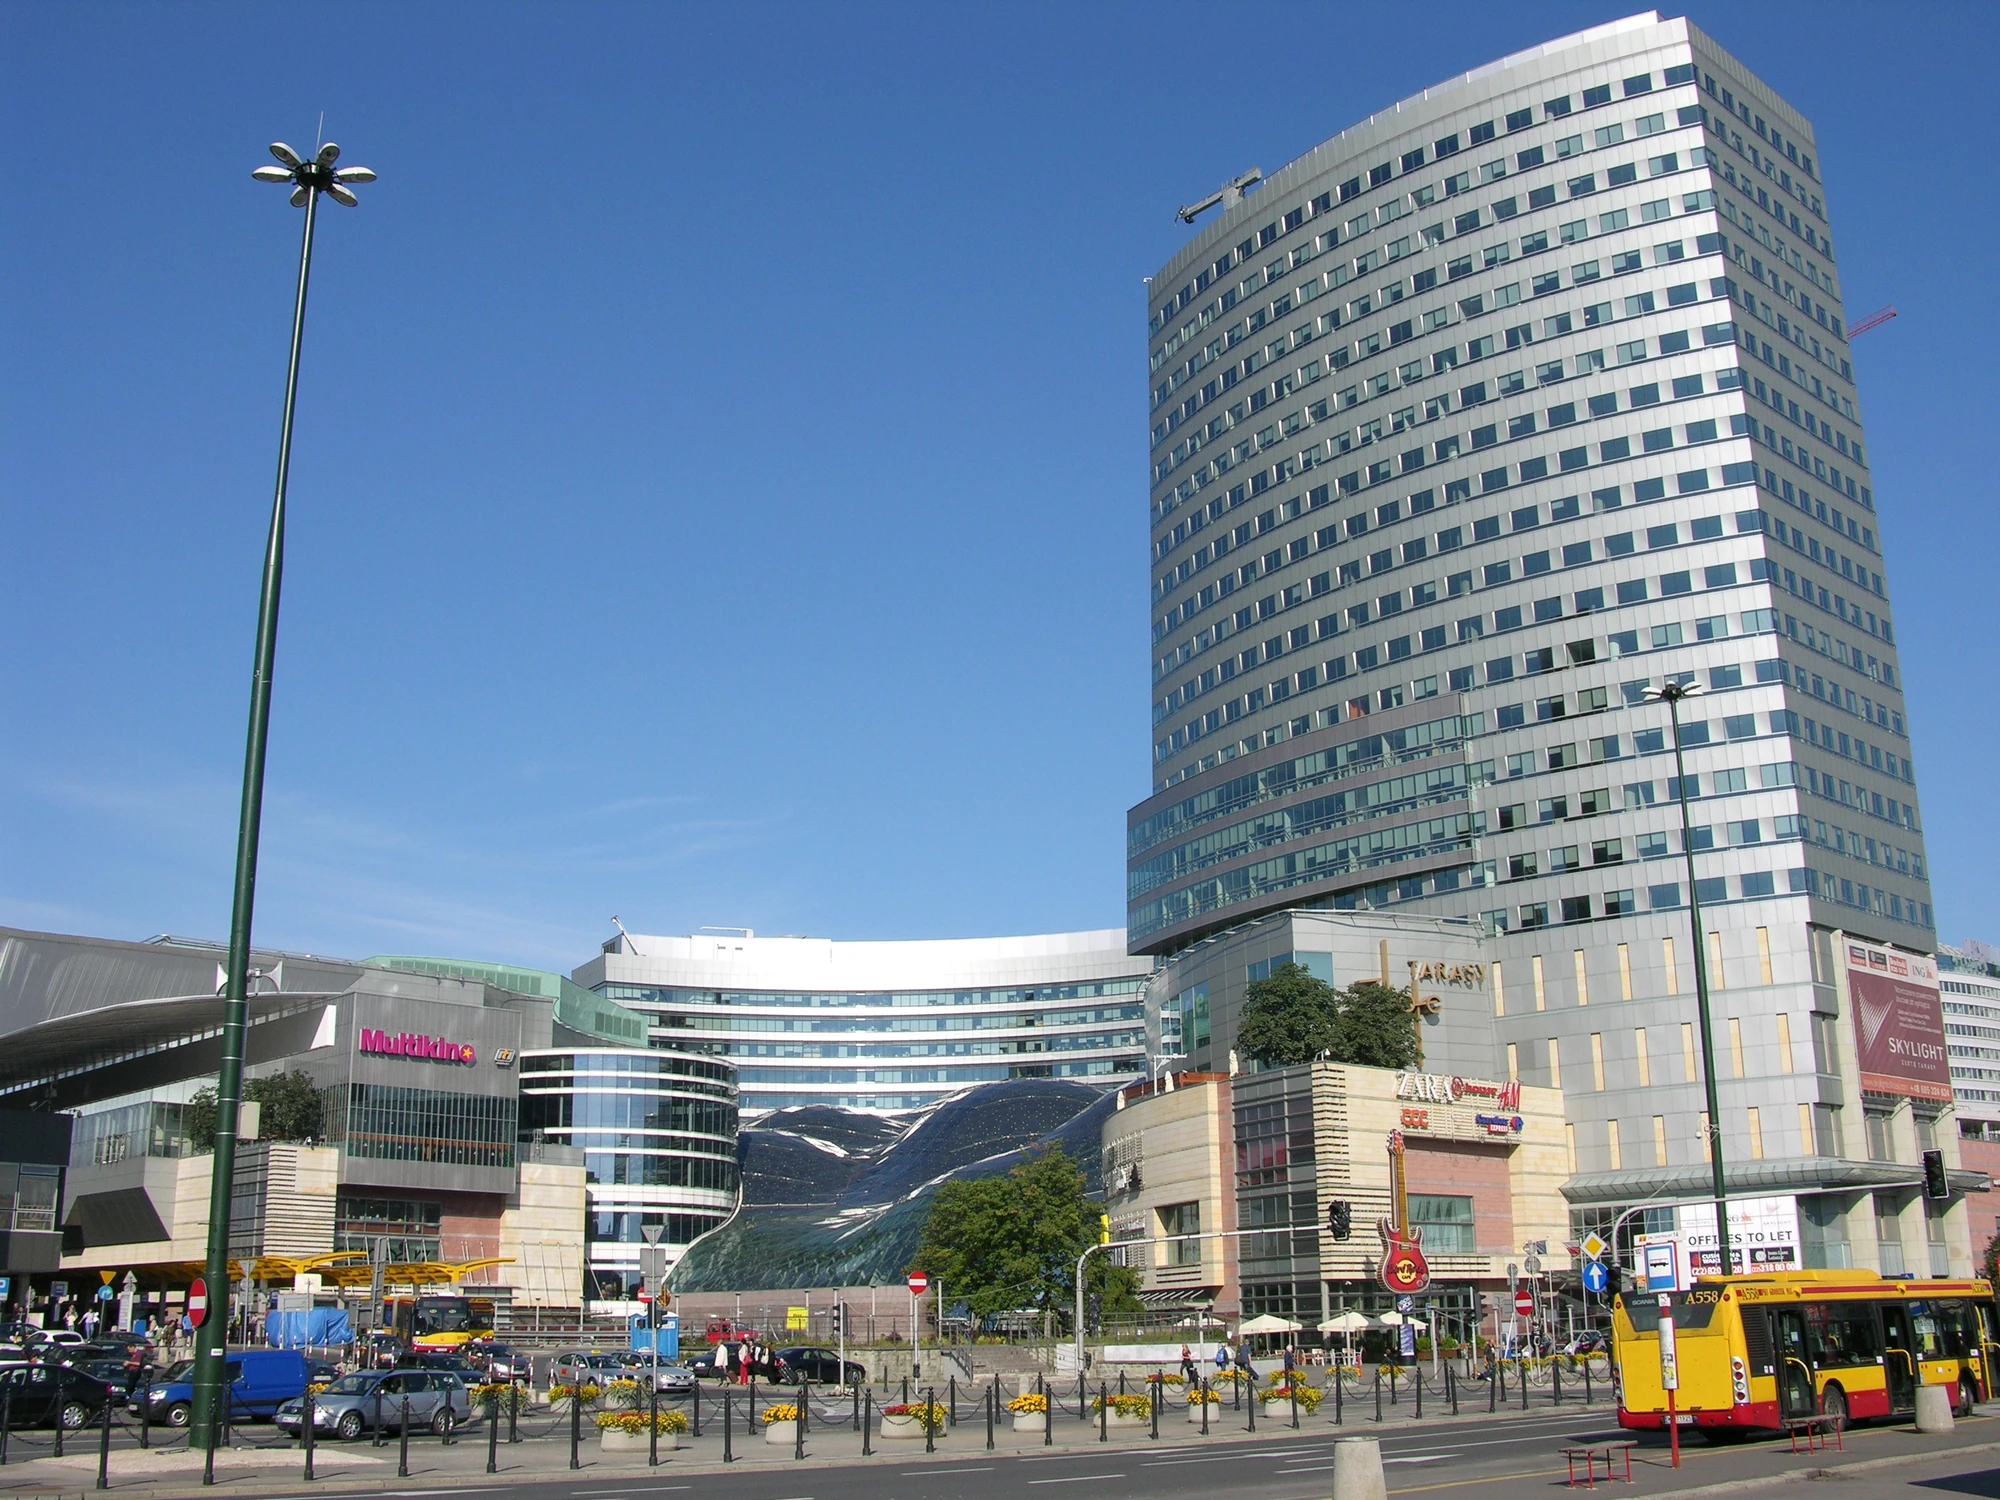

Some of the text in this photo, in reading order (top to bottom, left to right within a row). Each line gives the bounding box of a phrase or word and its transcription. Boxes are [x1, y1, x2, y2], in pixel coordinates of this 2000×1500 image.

[1407, 960, 1486, 982] TARASY
[1911, 965, 1926, 978] ING
[359, 1028, 476, 1063] Multikino
[1888, 1037, 1944, 1061] SKYLIGHT
[1397, 1070, 1455, 1102] ZARA
[1401, 1108, 1429, 1128] CCC
[1688, 1230, 1792, 1246] OFFIES TO LET
[1691, 1266, 1707, 1276] (22)
[1707, 1265, 1721, 1275] 820
[1760, 1264, 1774, 1273] 318
[1775, 1263, 1786, 1272] 00
[1786, 1262, 1796, 1271] 00
[1685, 1290, 1719, 1305] A558
[1742, 1287, 1759, 1301] A558
